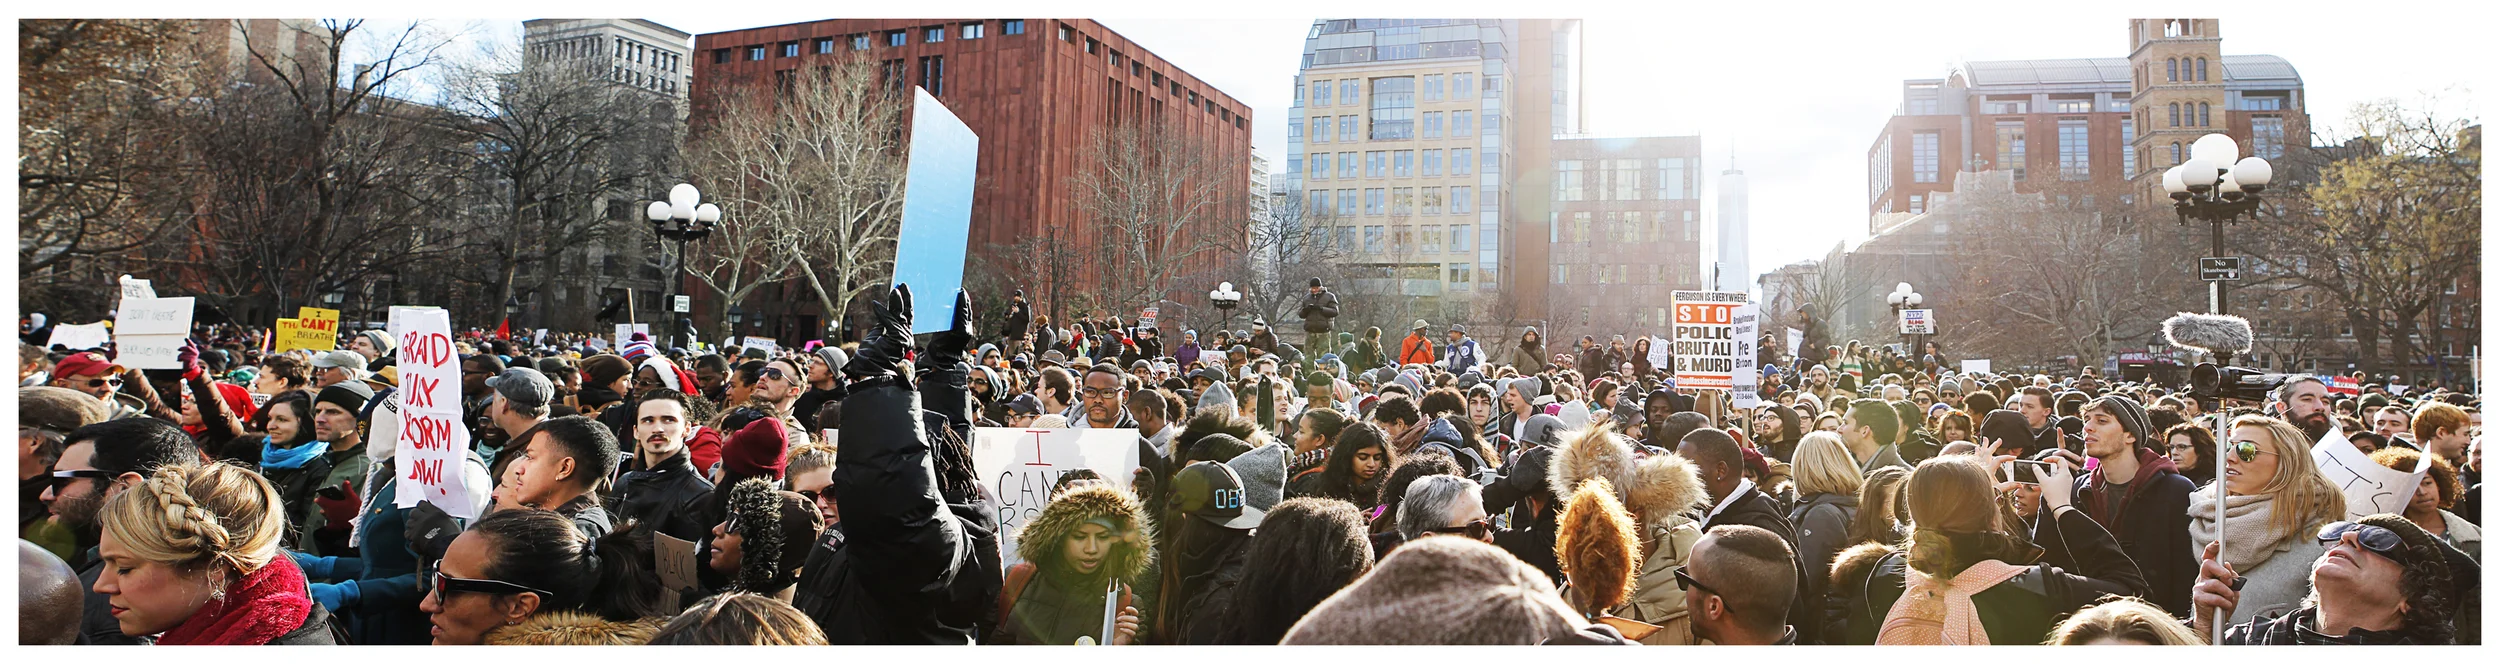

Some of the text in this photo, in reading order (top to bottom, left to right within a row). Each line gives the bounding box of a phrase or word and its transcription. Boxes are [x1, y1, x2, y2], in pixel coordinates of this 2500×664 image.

[1675, 291, 1747, 303] FERGUSON IS EVERYWHERE
[315, 310, 322, 318] I
[1679, 305, 1728, 323] STO
[296, 331, 335, 342] BREATHE
[1675, 326, 1732, 339] POLIC
[1676, 341, 1731, 356] BRUTALI
[1676, 358, 1732, 373] & MURD
[1677, 376, 1732, 387] StopMassIncarcerati
[1025, 430, 1053, 467] I
[998, 469, 1069, 507] CAN
